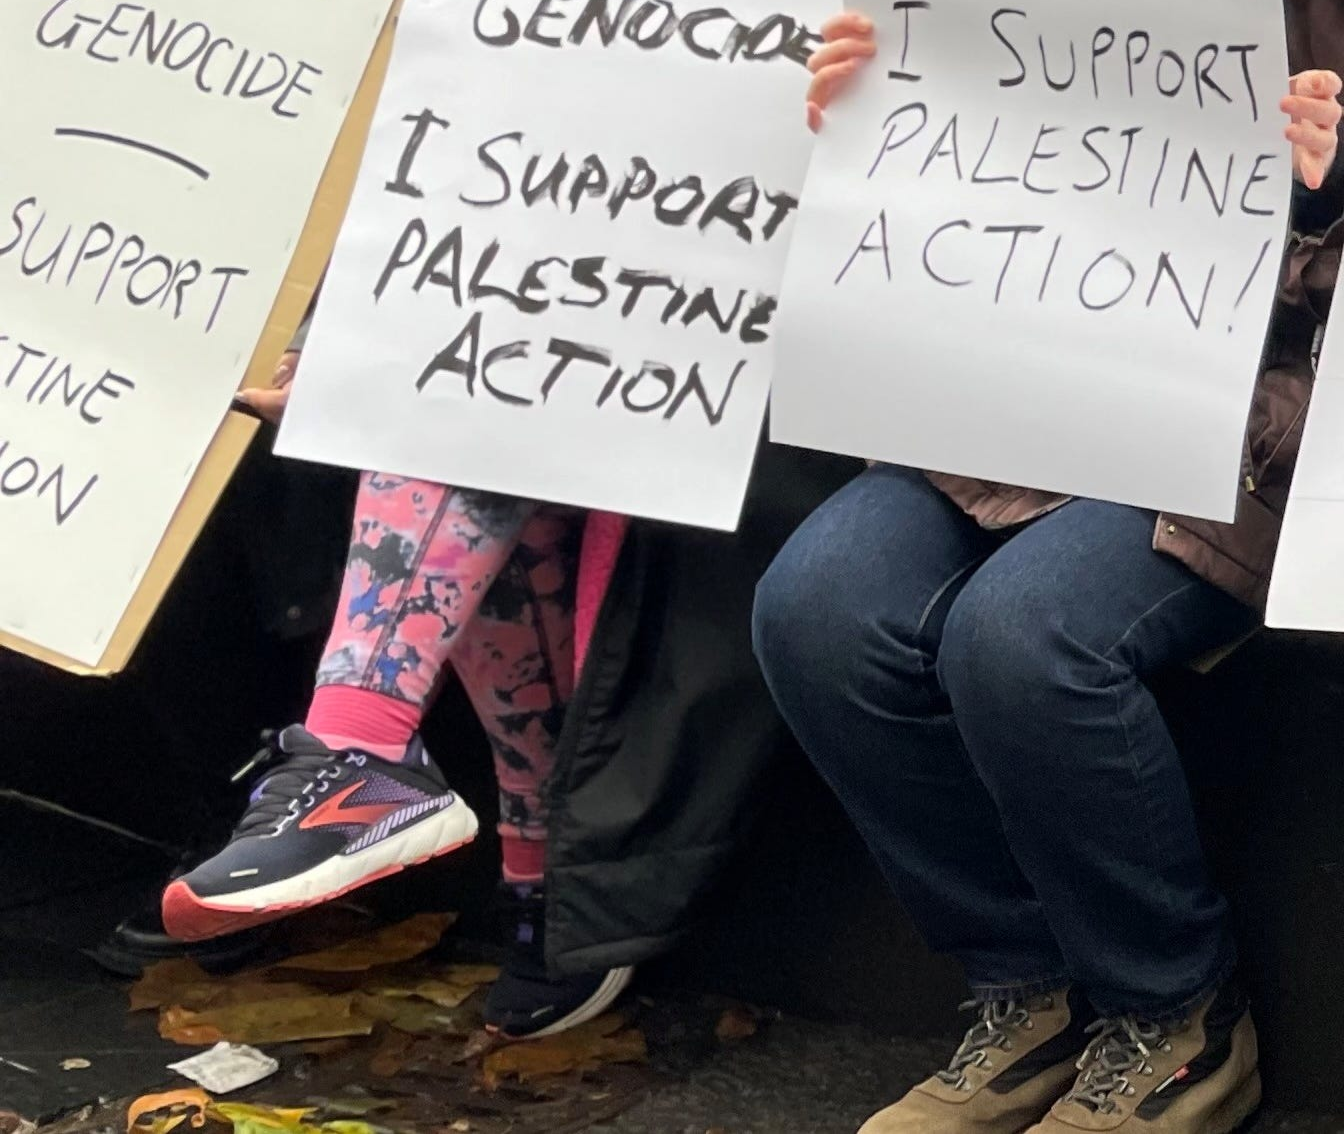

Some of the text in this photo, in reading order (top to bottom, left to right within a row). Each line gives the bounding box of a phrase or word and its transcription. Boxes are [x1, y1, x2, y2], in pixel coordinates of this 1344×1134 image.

[887, 0, 1260, 122] I SUPPORT
[384, 107, 799, 244] I SUPPORT
[866, 101, 1276, 217] PALESTINE
[0, 196, 249, 334] SUPPORT
[372, 218, 779, 344] PALESTINE
[834, 208, 1271, 334] ACTION!
[0, 336, 135, 424] TINE
[415, 312, 748, 426] ACTION
[0, 441, 98, 526] ON
